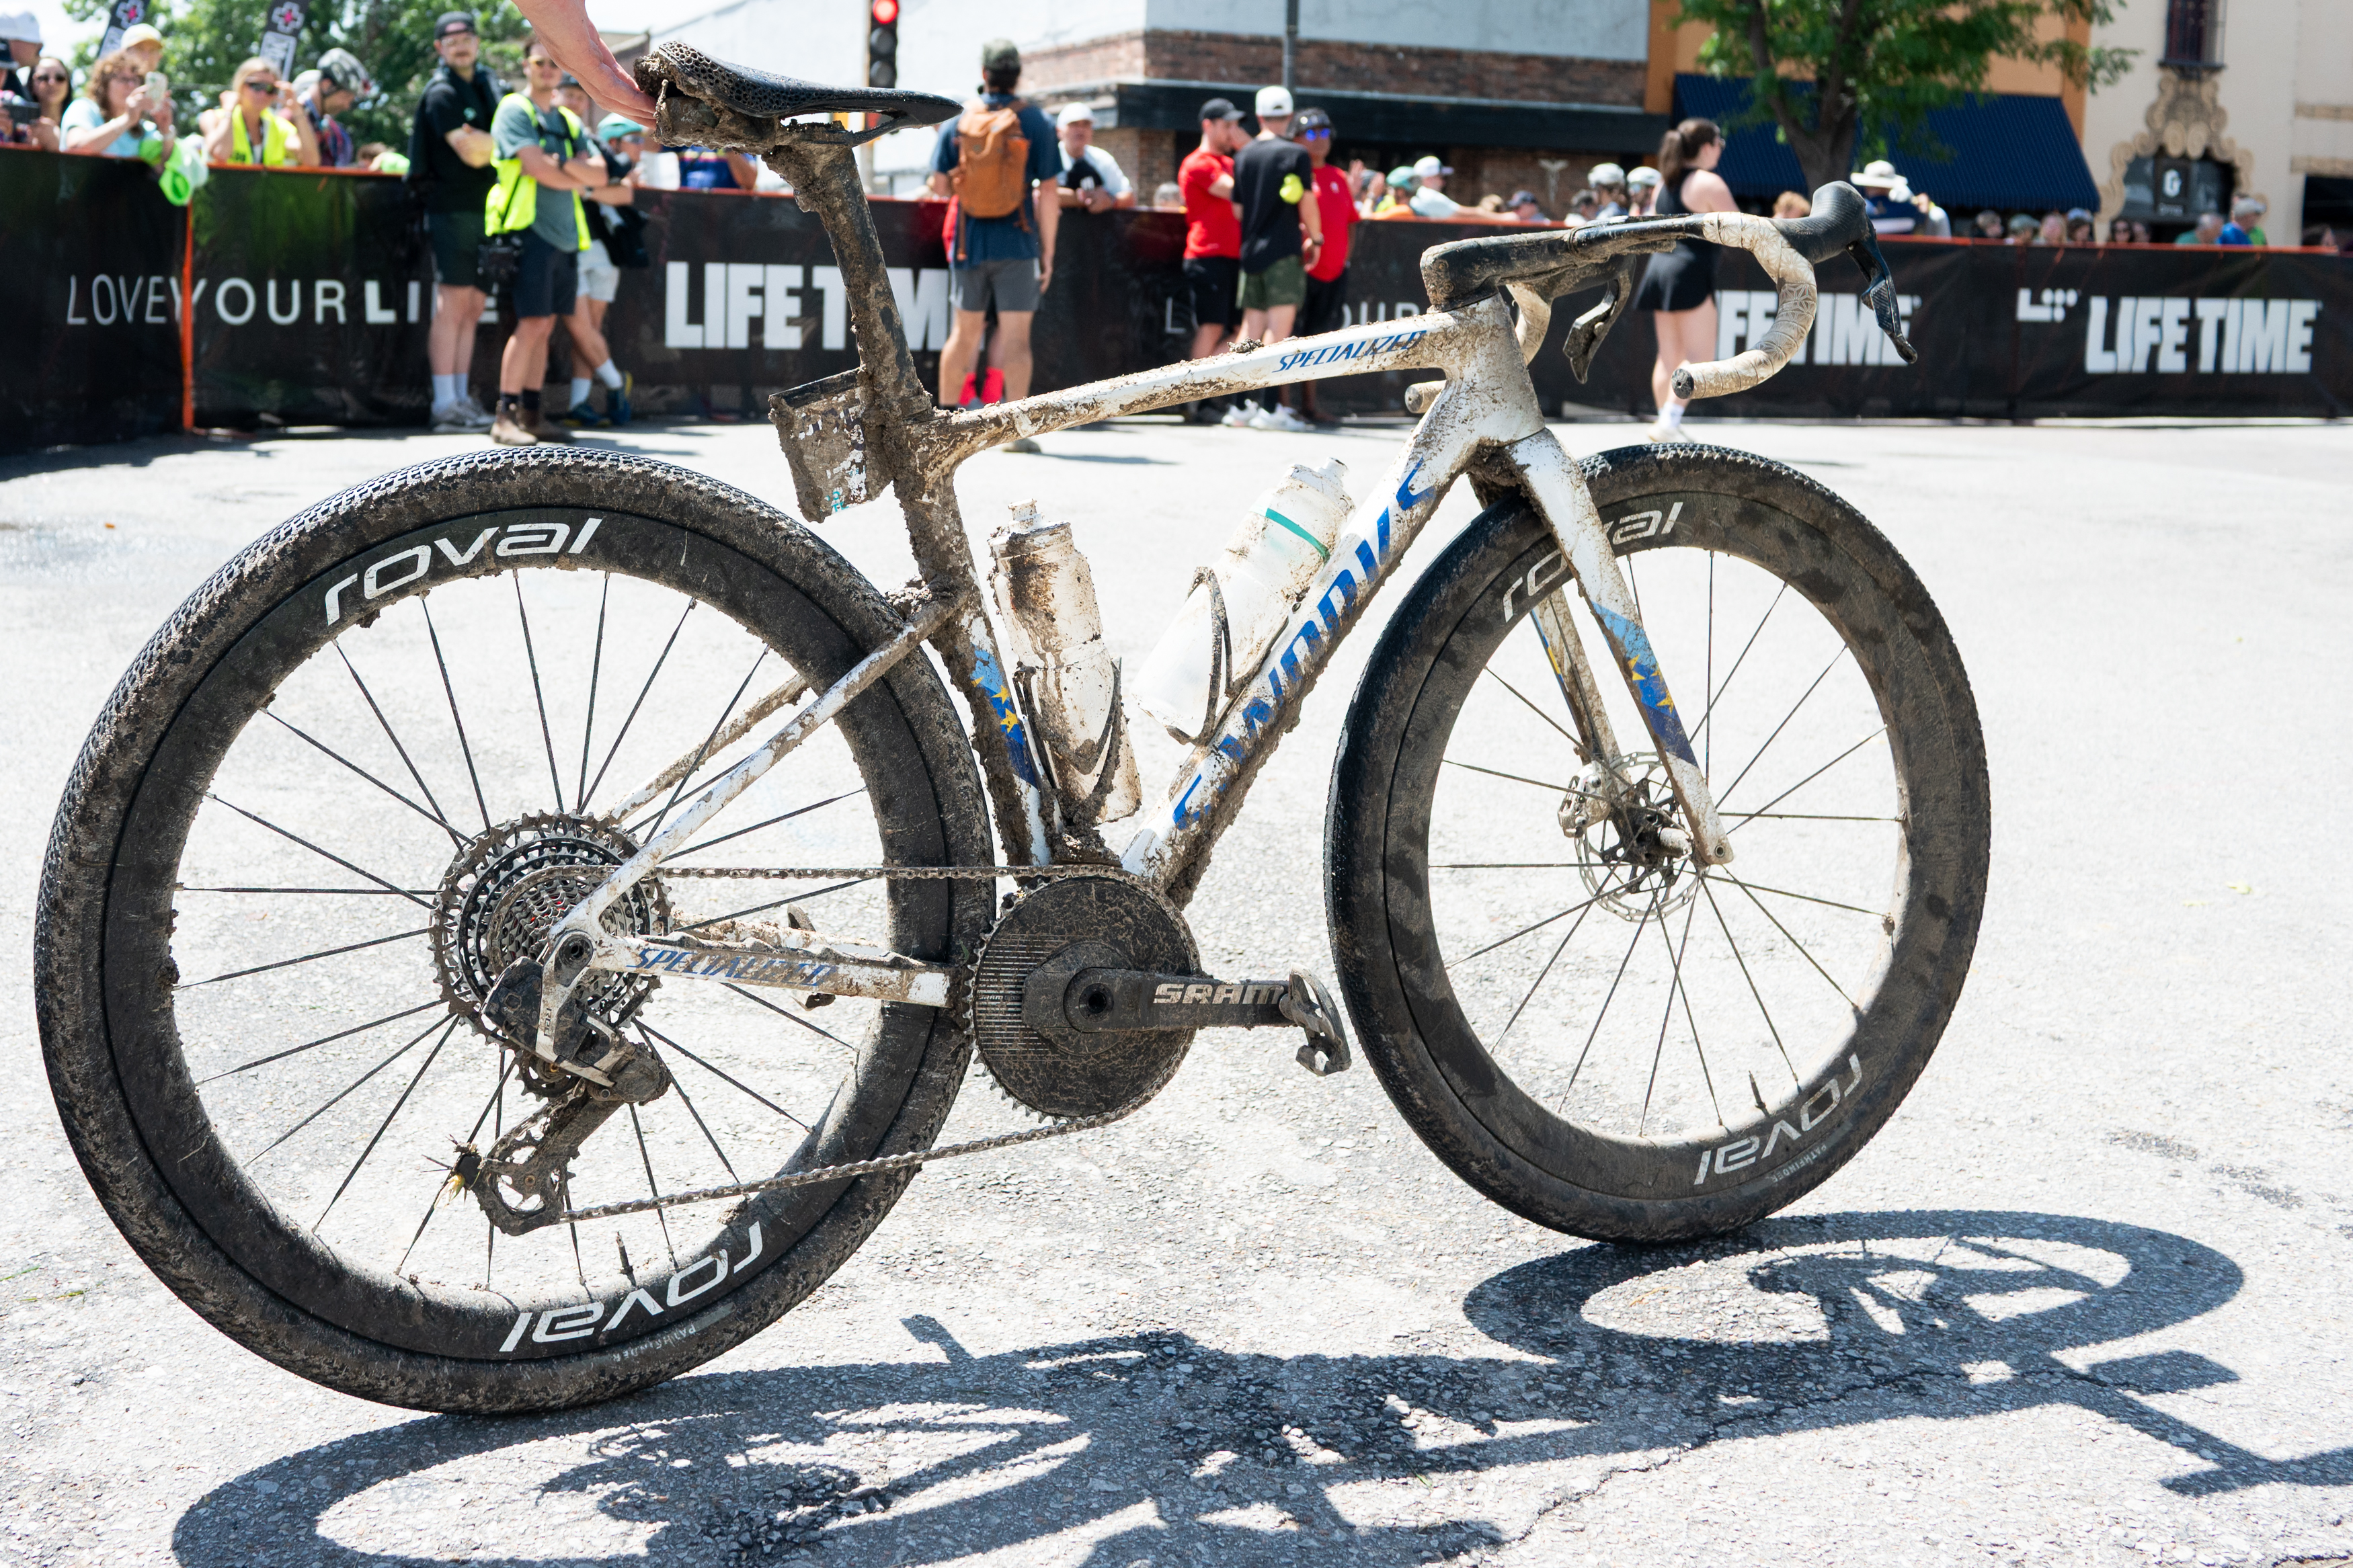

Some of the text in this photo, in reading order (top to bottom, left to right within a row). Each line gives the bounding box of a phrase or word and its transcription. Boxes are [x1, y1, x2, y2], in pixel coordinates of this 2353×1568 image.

[1272, 329, 1428, 373] SPECIALIZED
[325, 518, 603, 626] roval
[1503, 501, 1683, 623] roal
[1153, 983, 1285, 1005] SRAM
[1693, 1052, 1862, 1185] roval
[1771, 1144, 1827, 1183] PATHFINDER
[499, 1221, 764, 1352] roval
[612, 1323, 697, 1362] PATHFINDER
